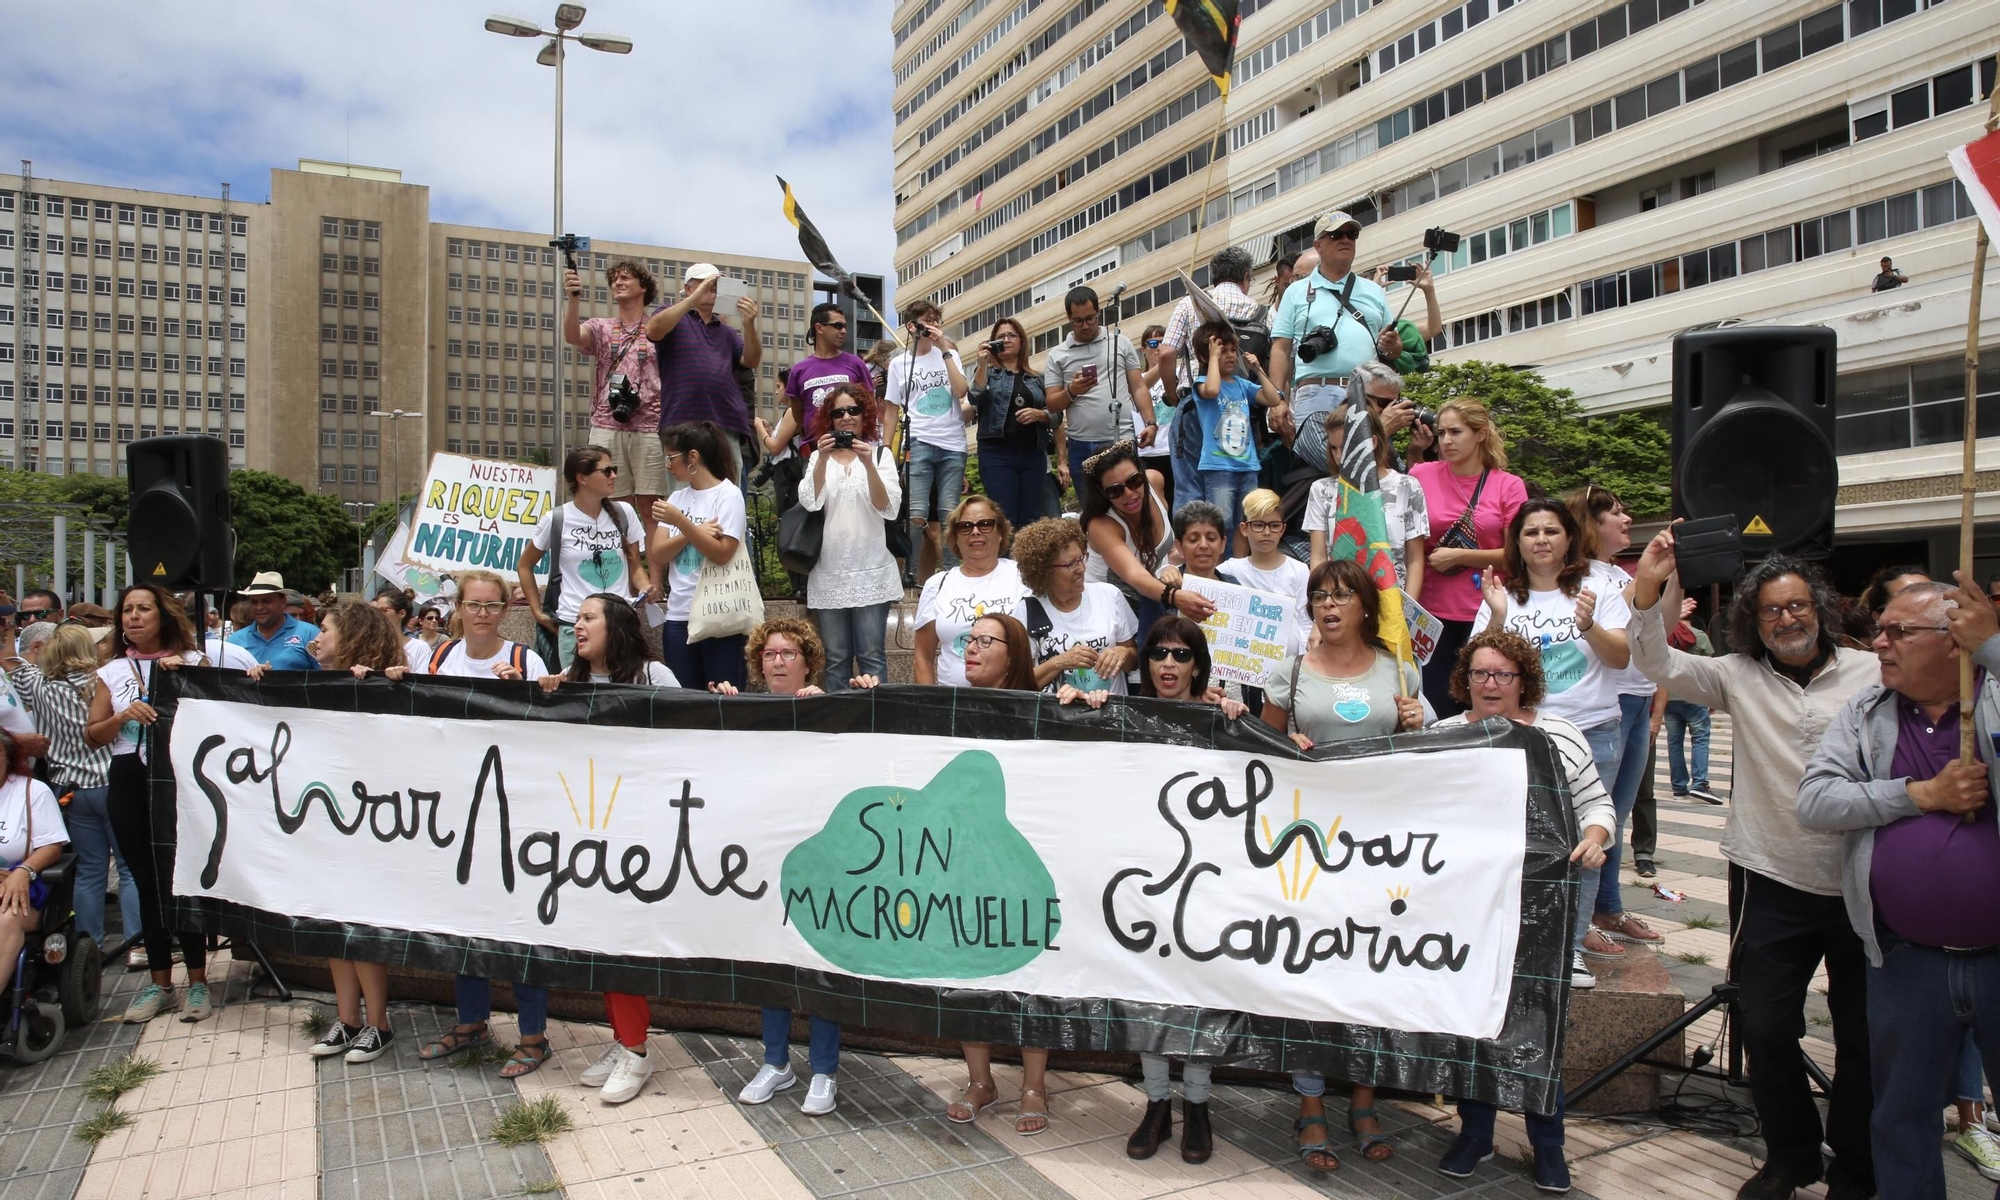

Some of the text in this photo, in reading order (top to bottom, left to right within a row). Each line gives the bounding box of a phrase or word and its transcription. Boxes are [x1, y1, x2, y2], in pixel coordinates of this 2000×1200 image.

[469, 463, 533, 484] NUESTRA
[426, 479, 552, 525] RIQUEZA
[442, 513, 500, 534] ES LA
[414, 522, 551, 575] NATURALA
[722, 566, 731, 577] IS
[734, 559, 751, 574] WHA
[703, 578, 752, 597] A FEMINIST
[702, 598, 752, 616] LOOKS LIKE
[1248, 594, 1284, 622] PODER
[1231, 614, 1254, 635] EN
[1254, 620, 1278, 641] LA
[1505, 609, 1577, 634] Salva
[1219, 632, 1234, 646] DE
[1249, 639, 1285, 662] PADRES
[1414, 628, 1435, 653] NO
[192, 721, 769, 925] Salvar Agaete
[1144, 759, 1446, 895] Salvar
[783, 884, 1062, 952] MACROMUELLE
